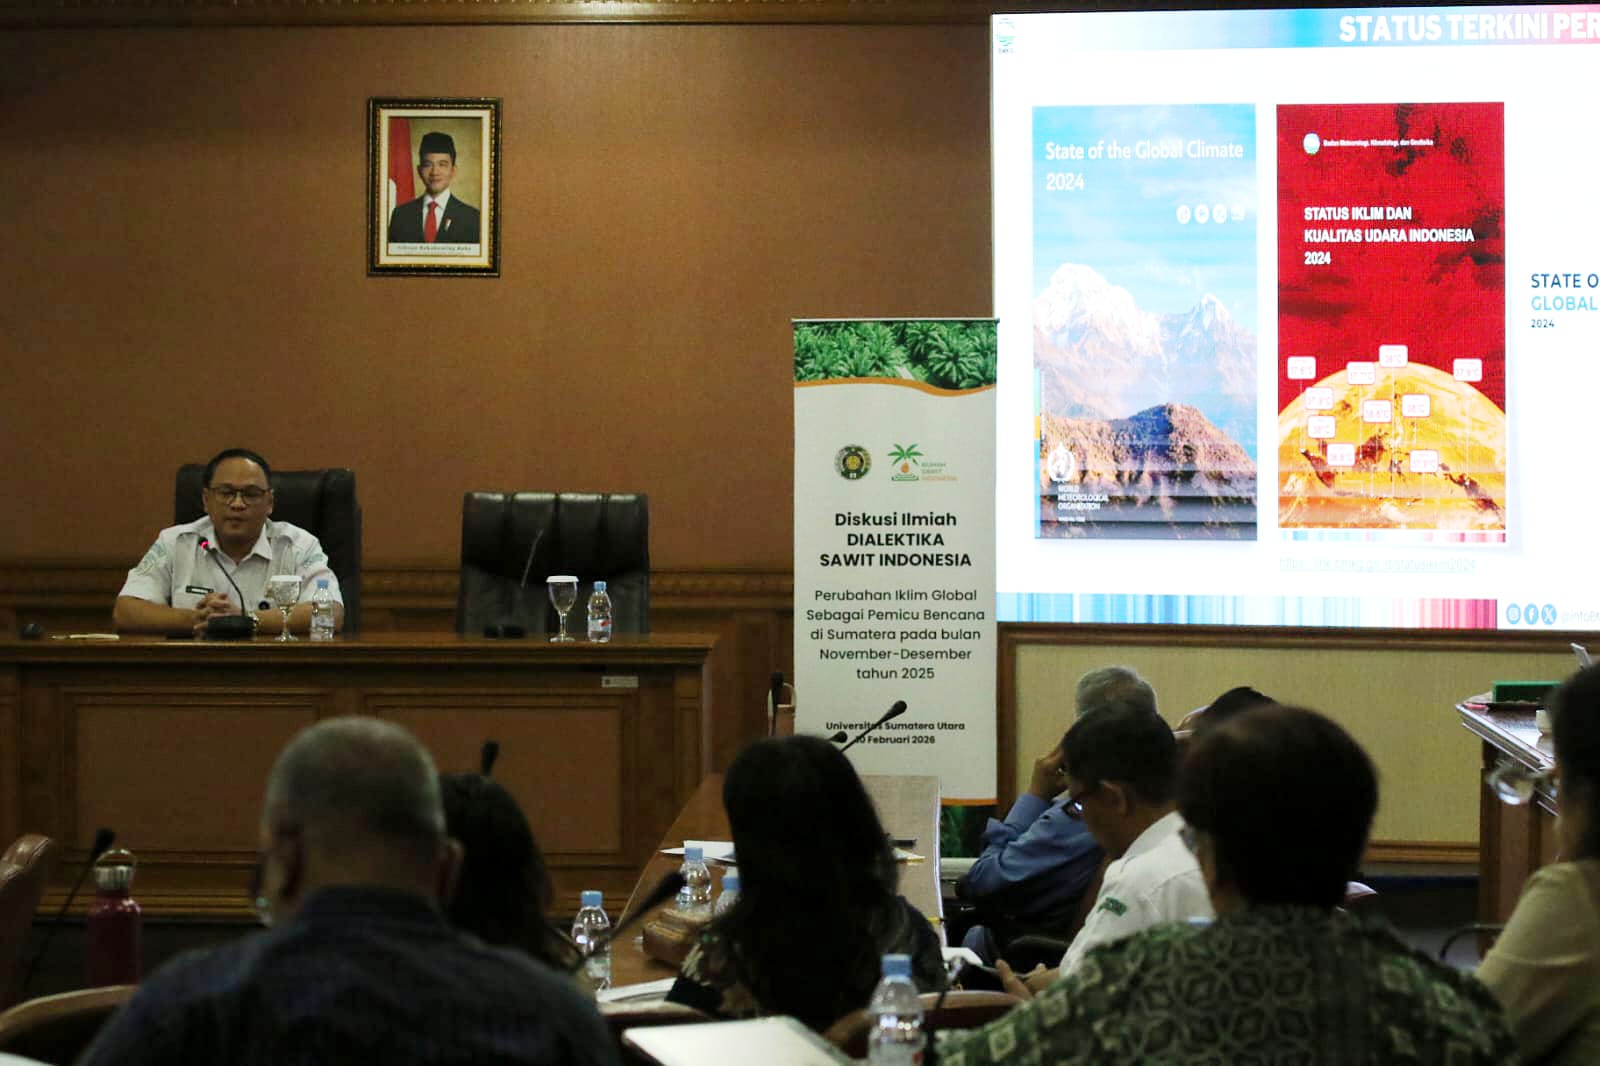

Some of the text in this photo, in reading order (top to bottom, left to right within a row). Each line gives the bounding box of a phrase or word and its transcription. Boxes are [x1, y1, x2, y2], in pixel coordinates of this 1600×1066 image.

[1339, 15, 1442, 42] STATUS
[1446, 13, 1547, 41] TERKINI
[1045, 140, 1244, 160] State of the Global Climate
[1046, 172, 1085, 191] 2024
[1304, 206, 1412, 220] STATUS IKLIM DAN
[1304, 228, 1475, 242] KUALITAS UDARA INDONESIA
[1304, 251, 1331, 265] 2024
[1531, 273, 1581, 288] STATE
[1531, 296, 1598, 311] GLOBAL
[1531, 319, 1554, 328] 2024
[835, 512, 957, 526] Diskusi Ilmiah
[847, 533, 945, 546] DIALEKTIKA
[820, 553, 972, 567] SAWIT INDONESIA
[815, 589, 977, 601] Perubahan Iklim Global
[807, 609, 985, 624] Sebagai Pemicu Bencana
[810, 628, 981, 643] di Sumatera pada bulan
[819, 648, 972, 660] November-Desember
[856, 667, 935, 679] tahun 2025
[884, 721, 935, 730] Sumatera
[937, 721, 965, 730] Utara
[867, 735, 910, 744] Februari
[911, 735, 935, 744] 2026
